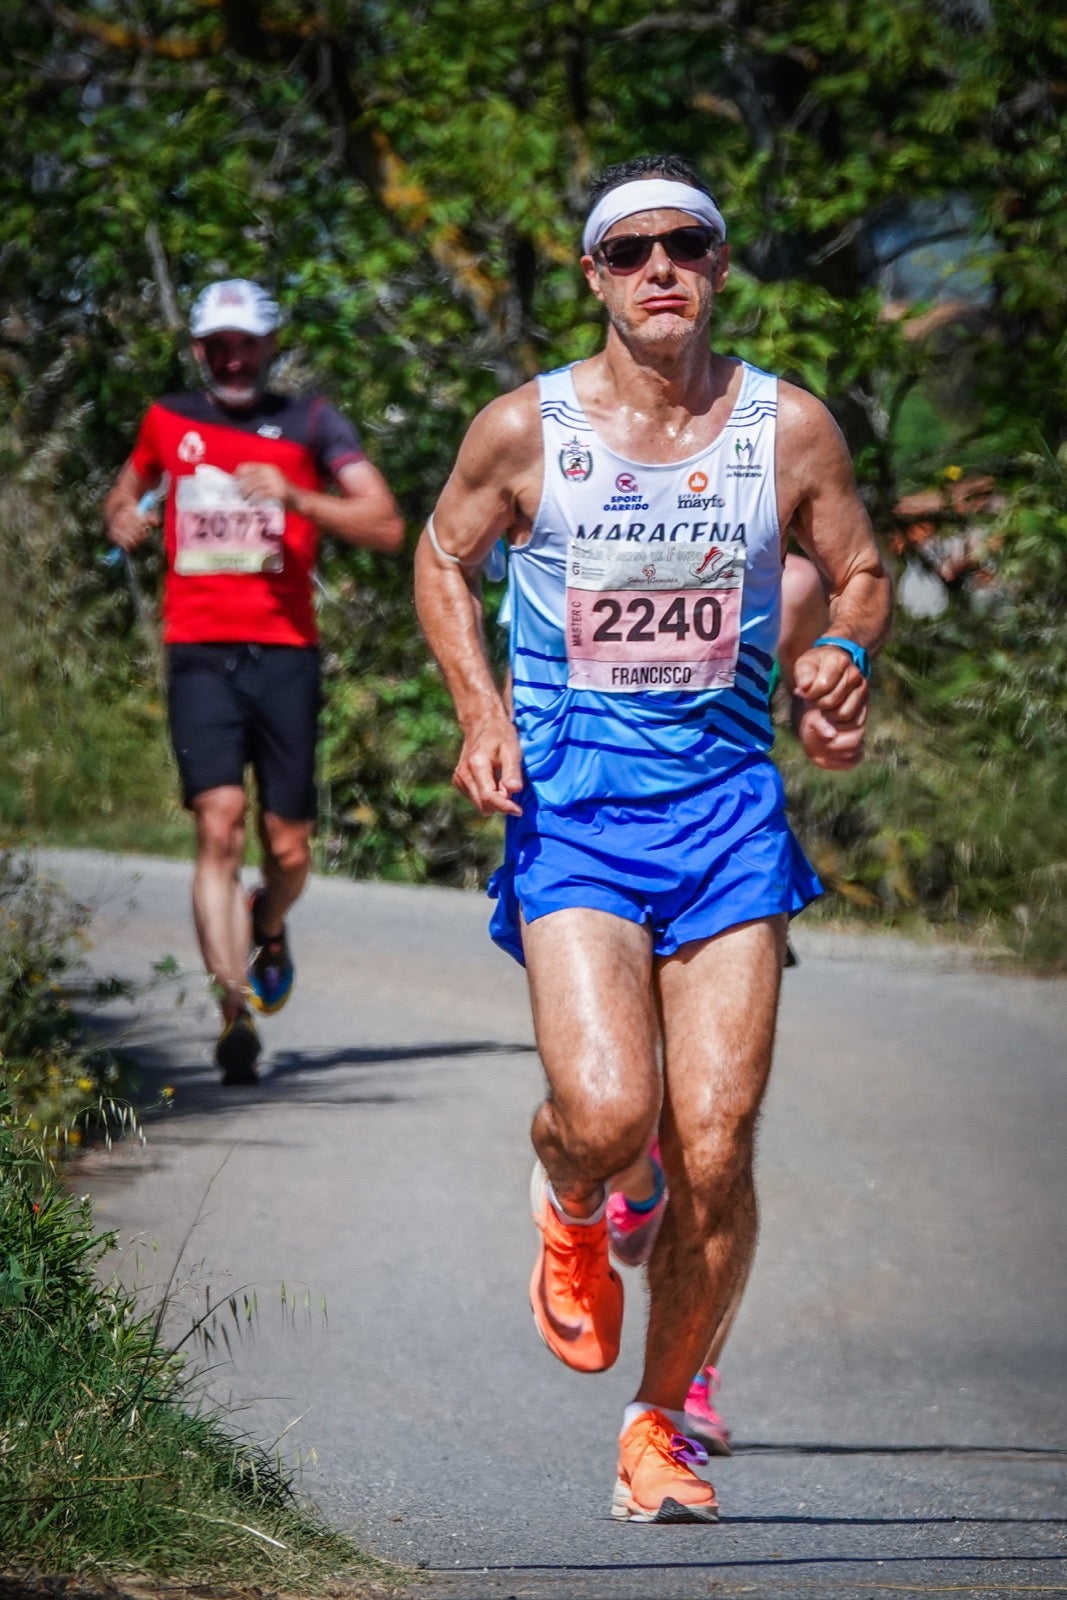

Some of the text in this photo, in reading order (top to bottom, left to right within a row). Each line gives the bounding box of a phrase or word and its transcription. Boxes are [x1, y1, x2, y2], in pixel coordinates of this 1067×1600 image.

[603, 503, 649, 511] GARRIDO
[610, 495, 643, 503] SPORT
[575, 521, 748, 545] MARACENA
[572, 609, 582, 647] MASTER
[592, 596, 723, 642] 2240
[611, 666, 692, 685] FRANCISCO
